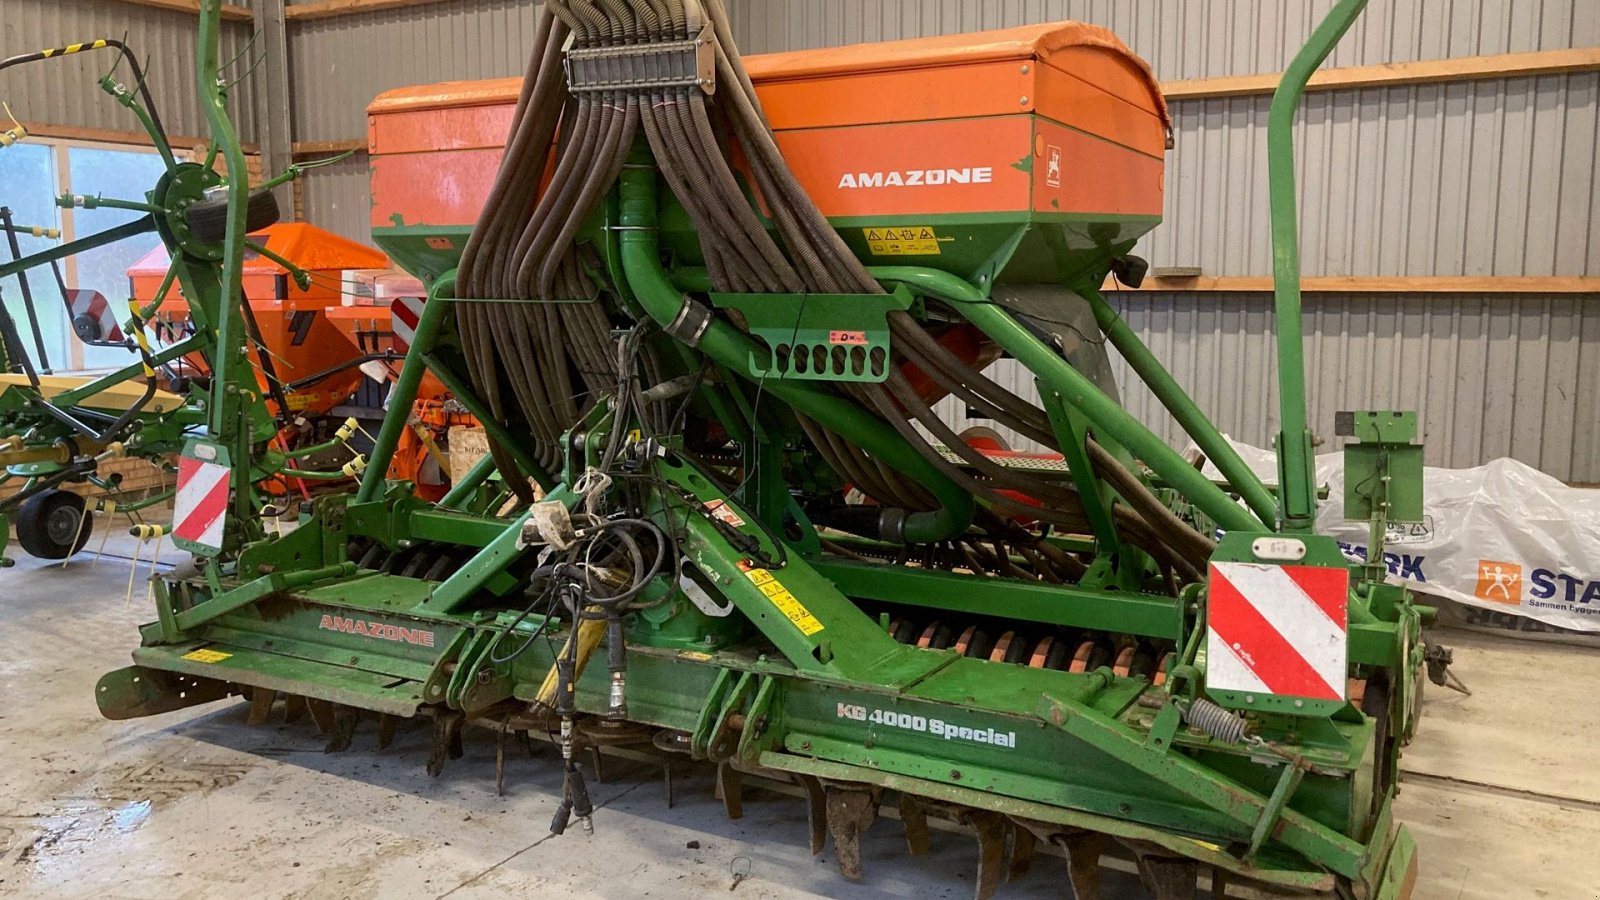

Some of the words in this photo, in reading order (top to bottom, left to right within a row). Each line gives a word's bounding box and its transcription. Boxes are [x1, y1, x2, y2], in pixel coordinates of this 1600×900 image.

[838, 167, 993, 189] AMAZONE
[1529, 568, 1600, 604] STA
[1529, 599, 1567, 611] Sammen
[1569, 604, 1600, 616] bygge
[319, 614, 434, 648] AMAZONE
[1239, 649, 1256, 666] reflex
[837, 702, 867, 721] KG
[869, 709, 927, 732] 4000
[928, 718, 1016, 749] Special
